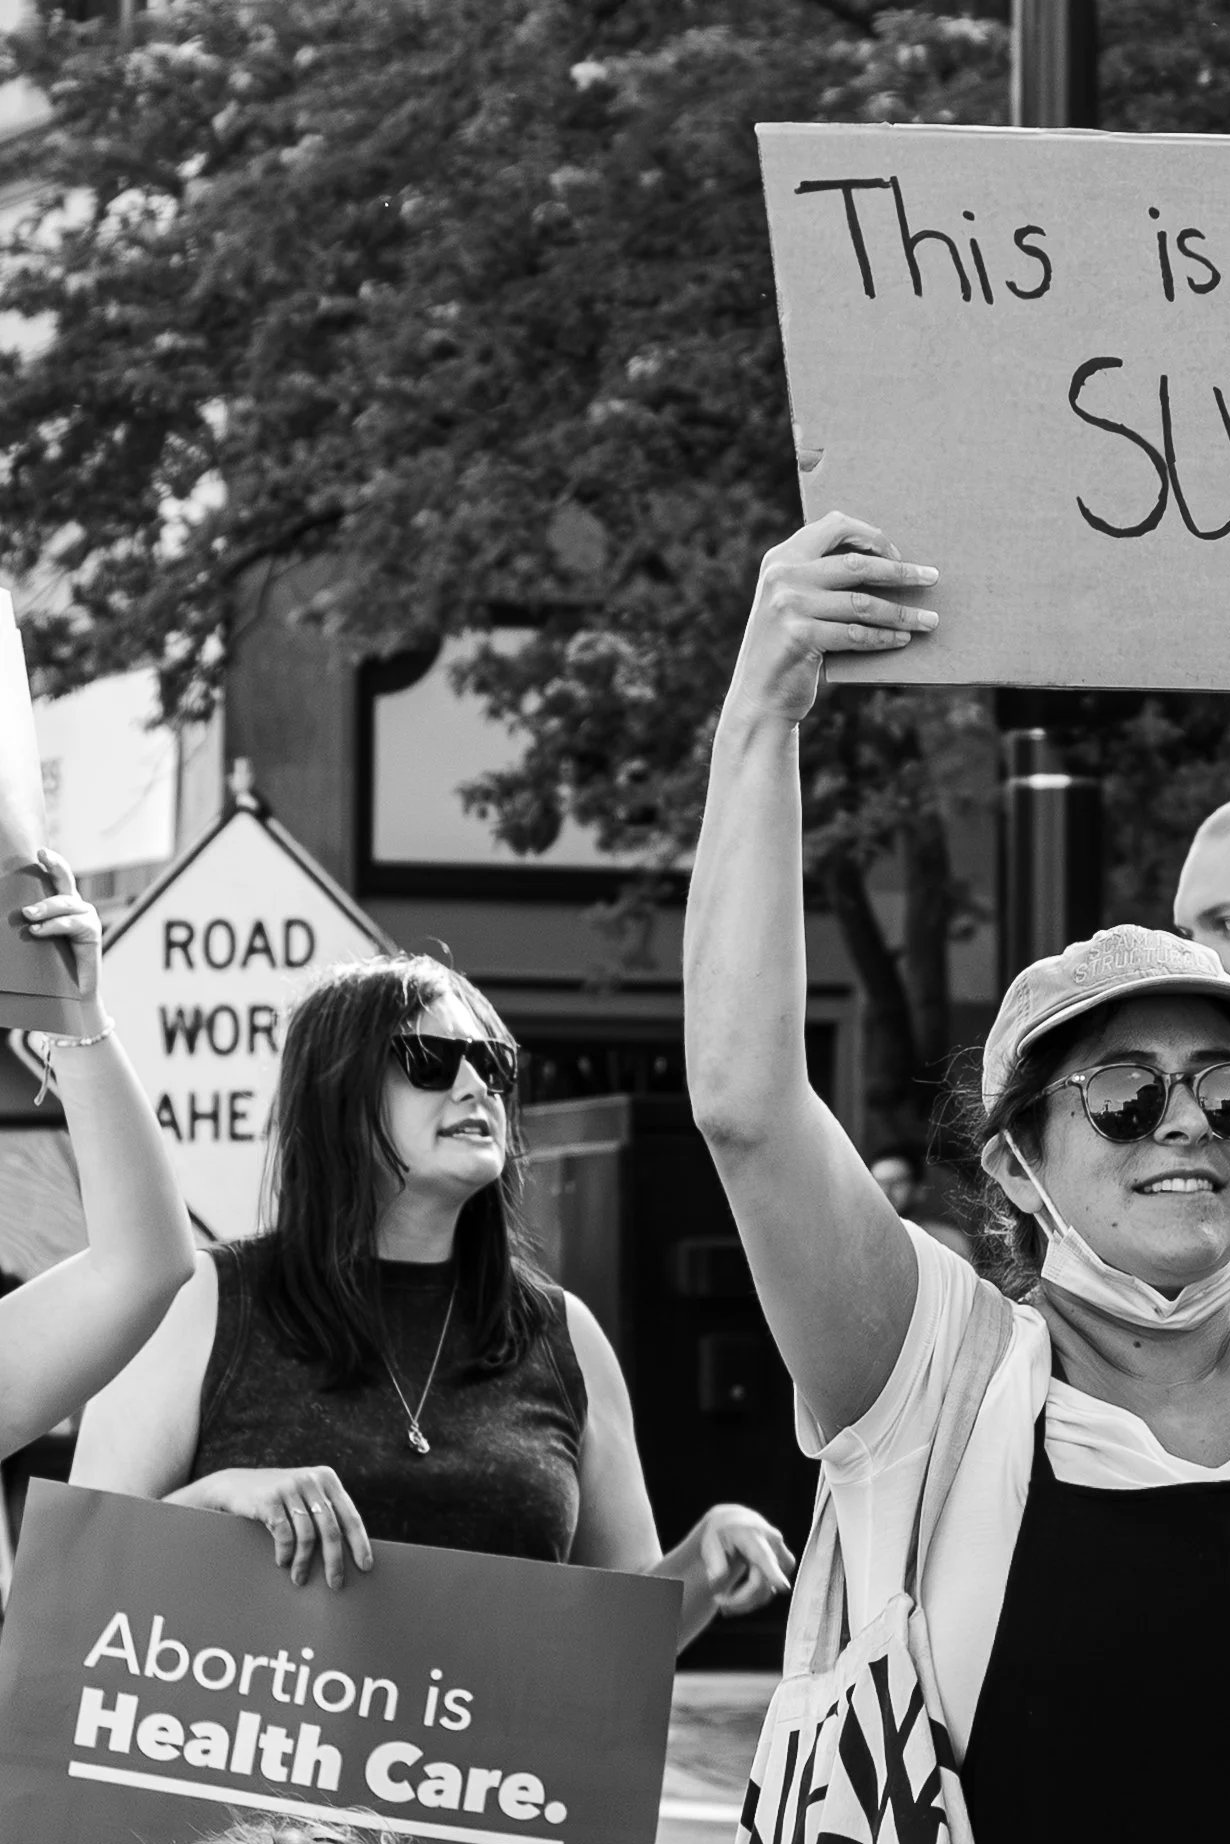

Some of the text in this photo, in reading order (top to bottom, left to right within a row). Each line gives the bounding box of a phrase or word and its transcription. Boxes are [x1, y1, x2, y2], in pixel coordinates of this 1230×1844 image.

[795, 176, 1052, 304] This
[1149, 208, 1221, 301] is
[165, 918, 315, 969] ROAD
[160, 1004, 279, 1055] WOR
[157, 1091, 255, 1142] AHE
[83, 1612, 474, 1731] Abortion is
[74, 1687, 567, 1825] Health Care.
